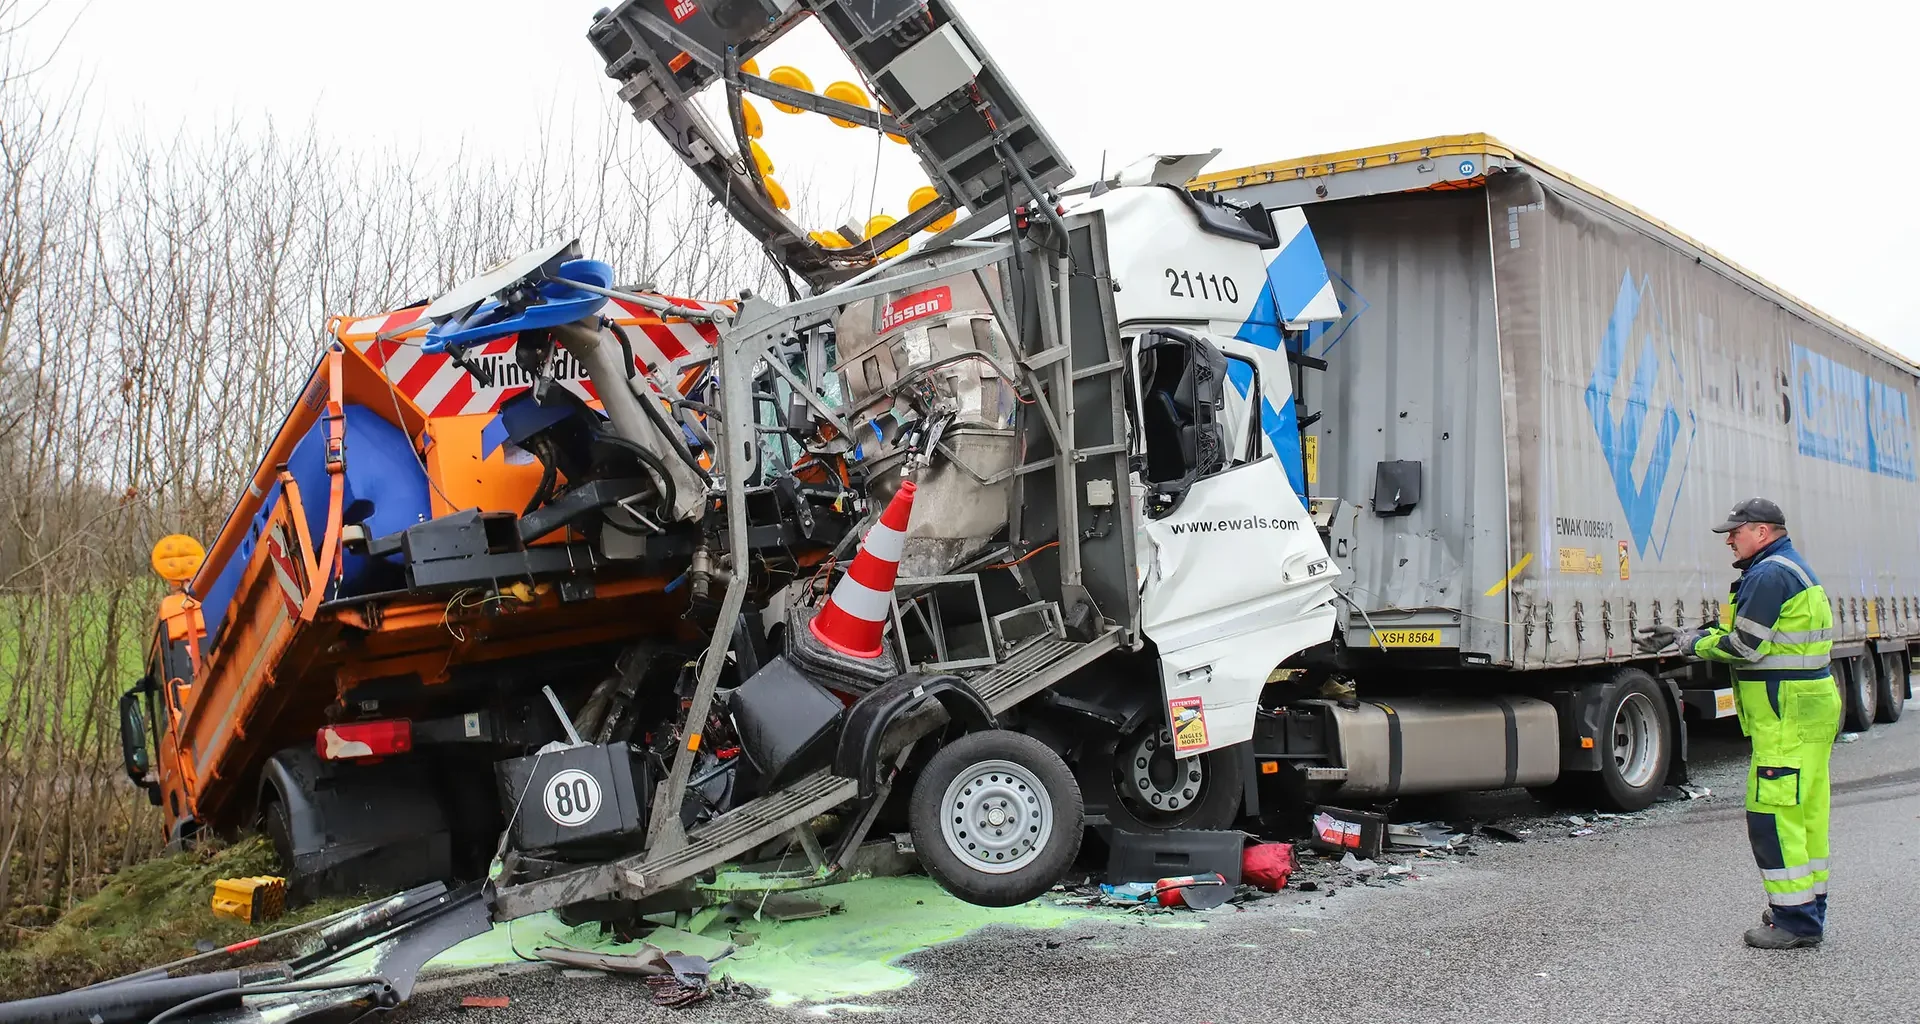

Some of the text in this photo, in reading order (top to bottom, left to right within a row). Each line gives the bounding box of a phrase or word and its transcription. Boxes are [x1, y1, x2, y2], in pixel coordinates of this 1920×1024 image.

[1164, 267, 1239, 304] 21110
[881, 299, 939, 330] nissen
[1170, 515, 1300, 535] www.ewals.com
[1556, 517, 1582, 536] EWAK
[1381, 632, 1435, 644] XSH 8564
[1171, 699, 1200, 707] ATTENTION
[1179, 732, 1203, 740] ANGLES
[554, 778, 591, 817] 80
